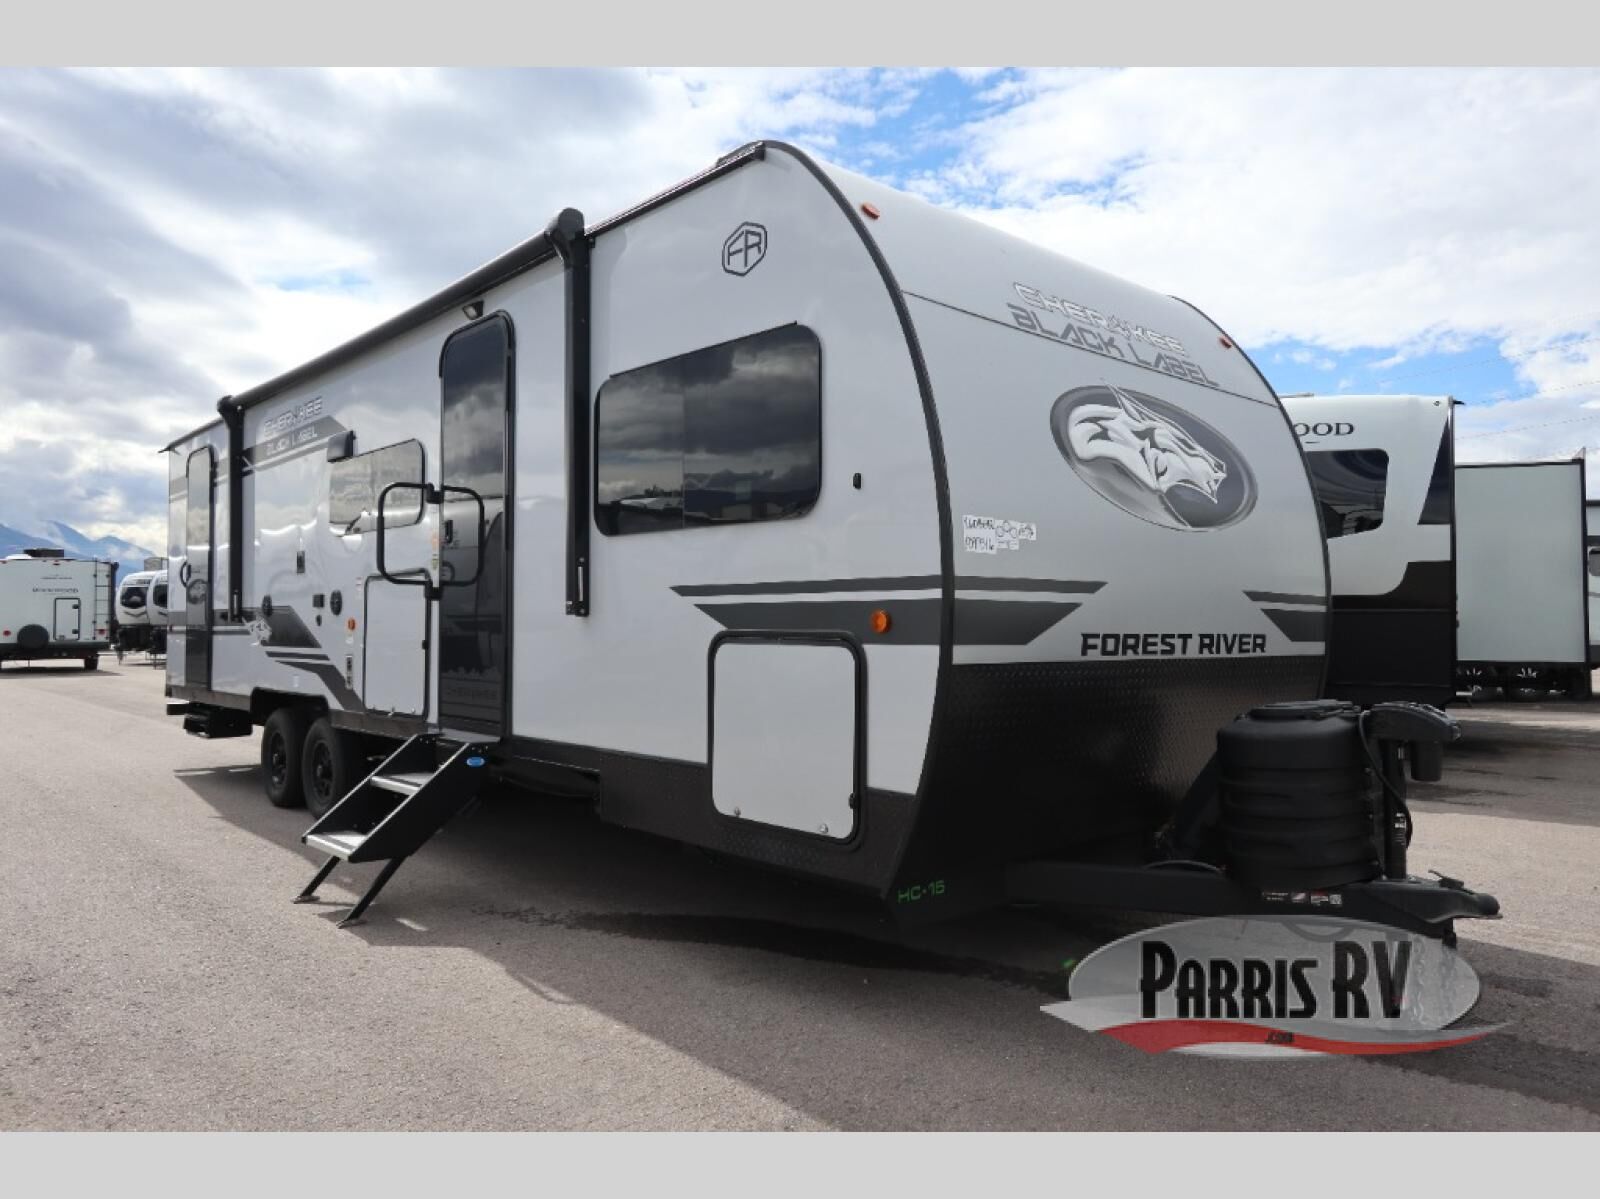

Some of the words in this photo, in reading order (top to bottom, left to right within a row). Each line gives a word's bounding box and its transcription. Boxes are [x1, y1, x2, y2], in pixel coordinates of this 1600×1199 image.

[1006, 302, 1125, 358] BLACK
[1127, 342, 1220, 387] LABEL
[1080, 633, 1193, 656] FOREST
[1198, 633, 1267, 654] RIVER
